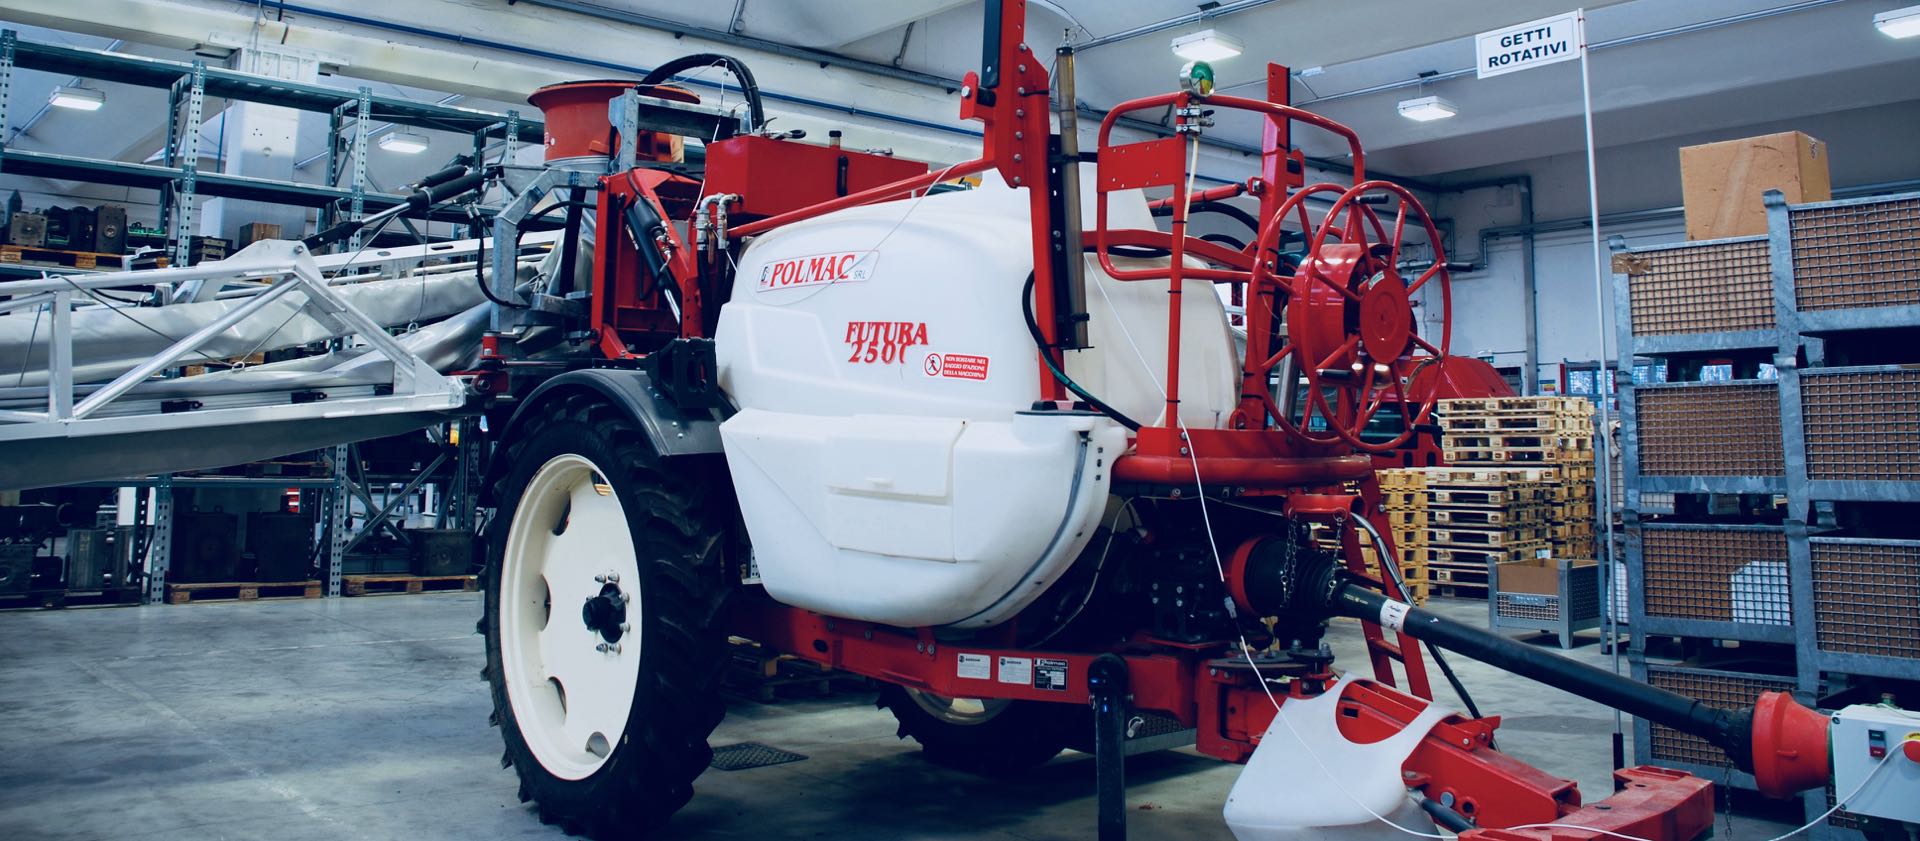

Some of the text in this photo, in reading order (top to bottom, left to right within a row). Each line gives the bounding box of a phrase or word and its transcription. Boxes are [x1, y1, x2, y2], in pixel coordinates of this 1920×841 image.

[1500, 26, 1551, 48] GETTI
[1488, 40, 1567, 68] ROTATIVI
[769, 254, 866, 287] POLMAC SRL
[845, 321, 929, 345] FUTURA
